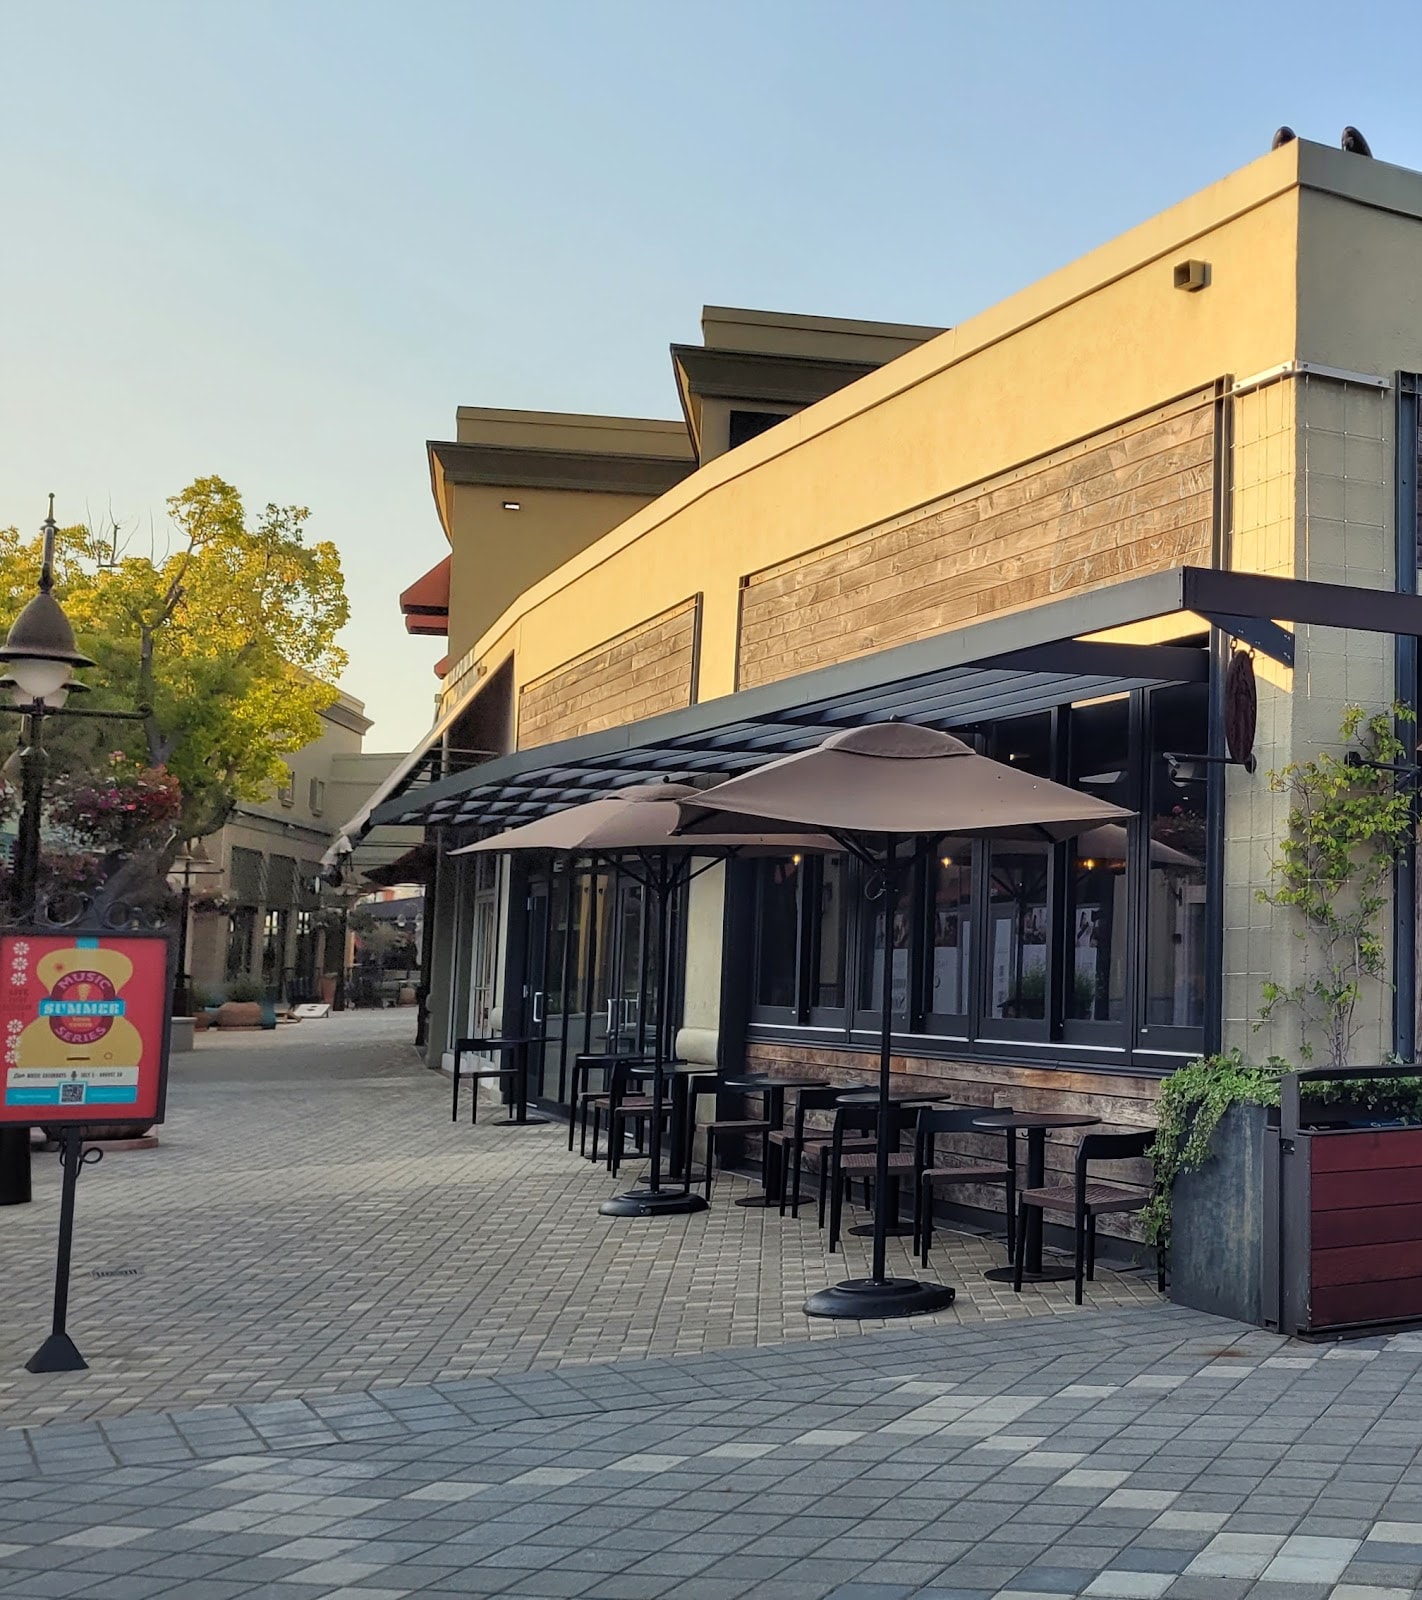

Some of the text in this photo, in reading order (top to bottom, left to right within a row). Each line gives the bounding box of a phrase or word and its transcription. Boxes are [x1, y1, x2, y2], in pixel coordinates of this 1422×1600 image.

[57, 972, 111, 989] MUSIC
[43, 1002, 120, 1015] SUMMER
[55, 1026, 107, 1042] SERIES
